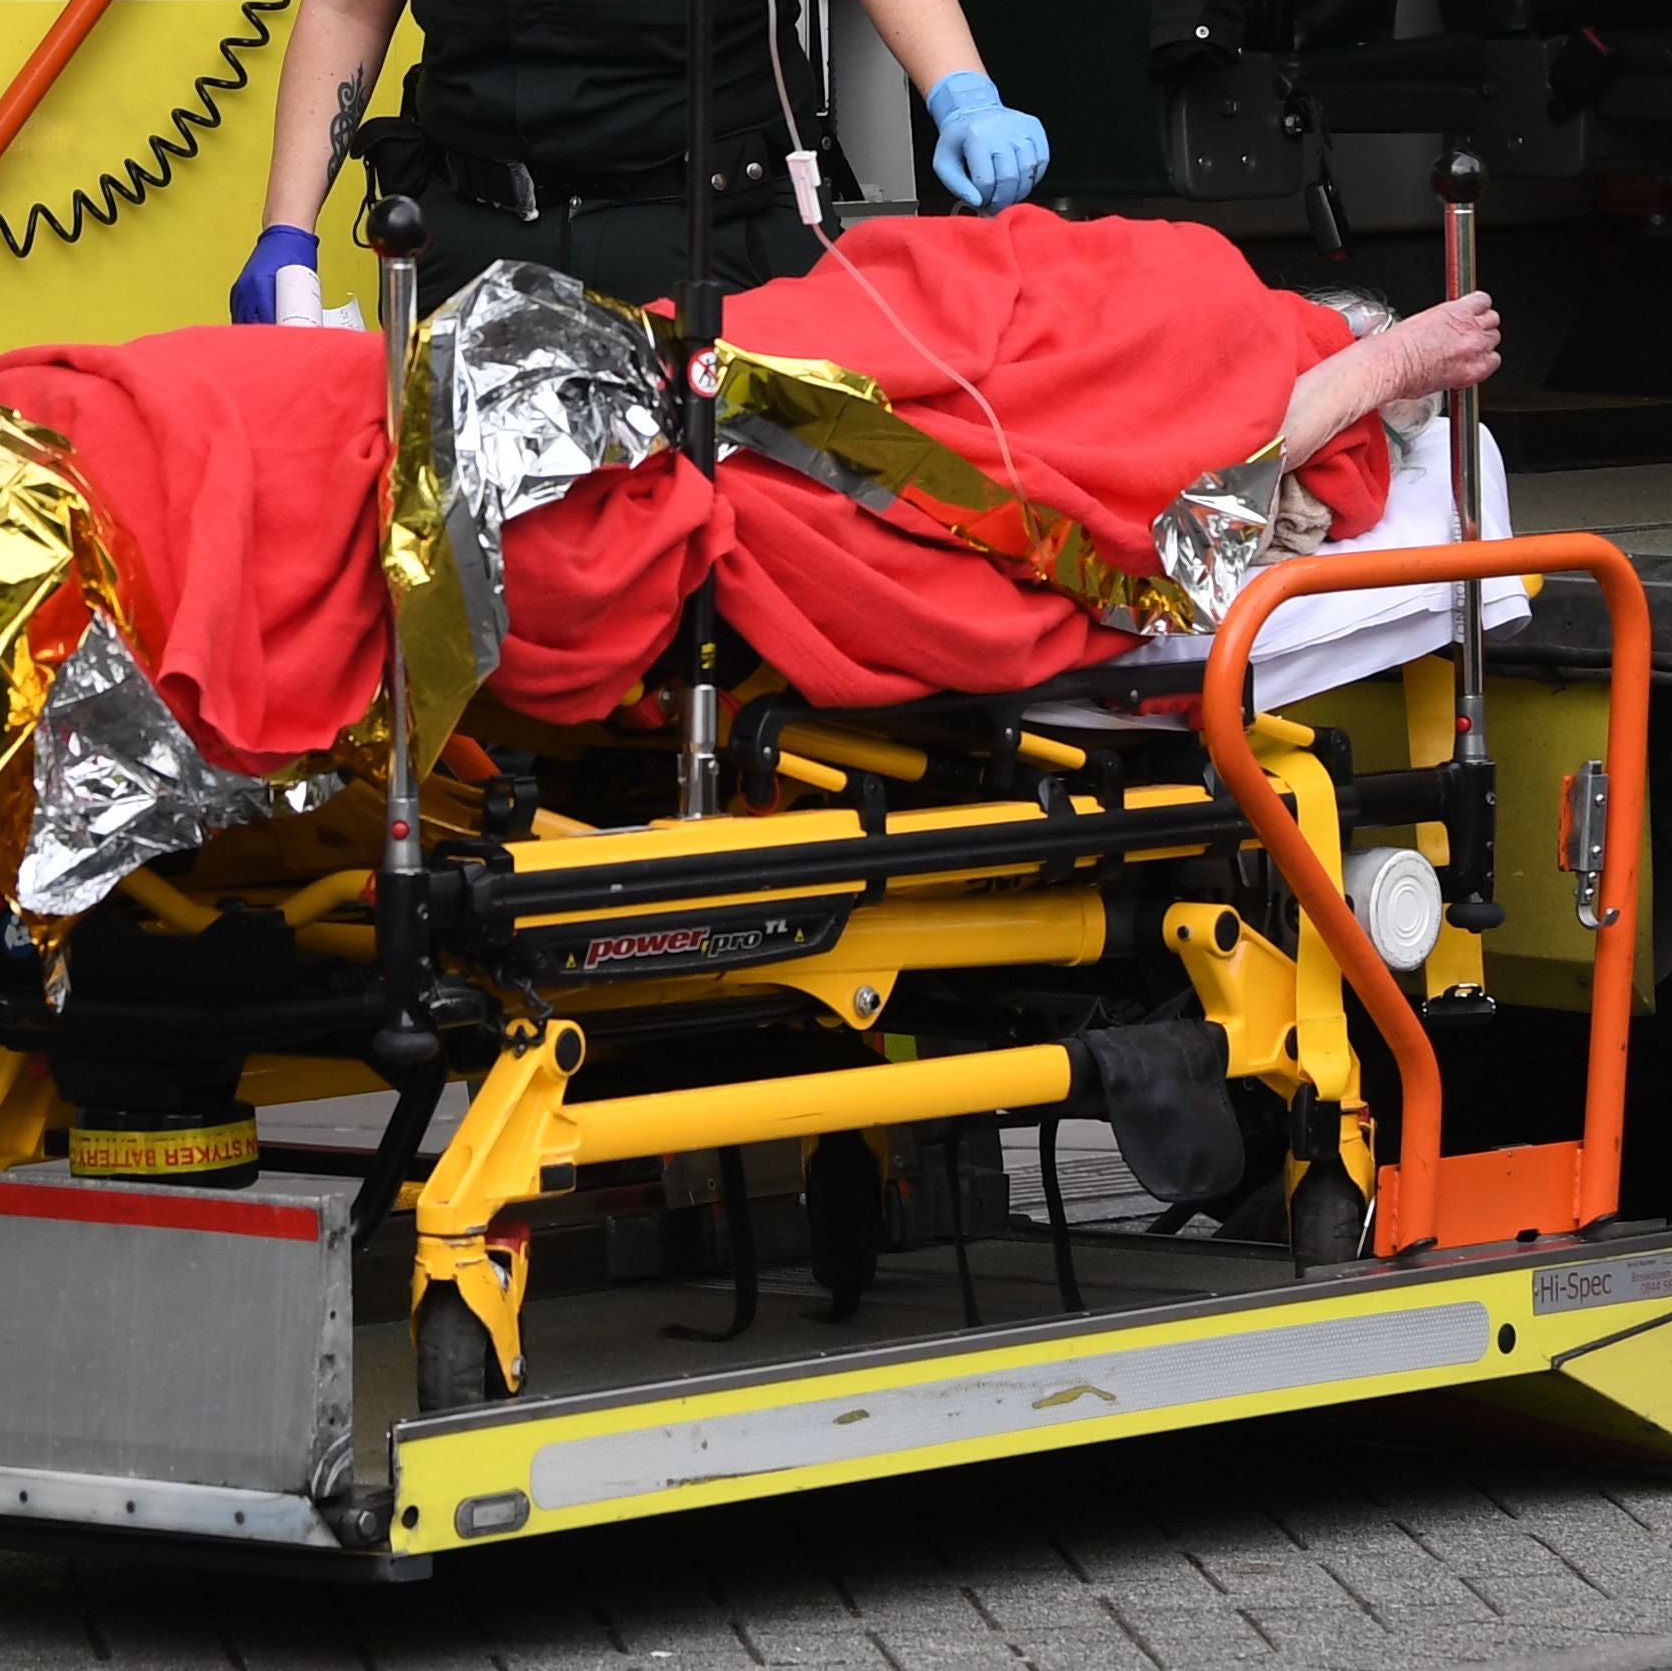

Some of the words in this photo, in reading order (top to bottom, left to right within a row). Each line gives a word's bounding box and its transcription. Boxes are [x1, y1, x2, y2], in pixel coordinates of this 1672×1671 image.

[583, 927, 711, 970] power
[707, 929, 763, 958] pro
[78, 1148, 157, 1168] BATTERY
[164, 1139, 242, 1167] STYKER
[1541, 1271, 1613, 1304] Hi-Spec
